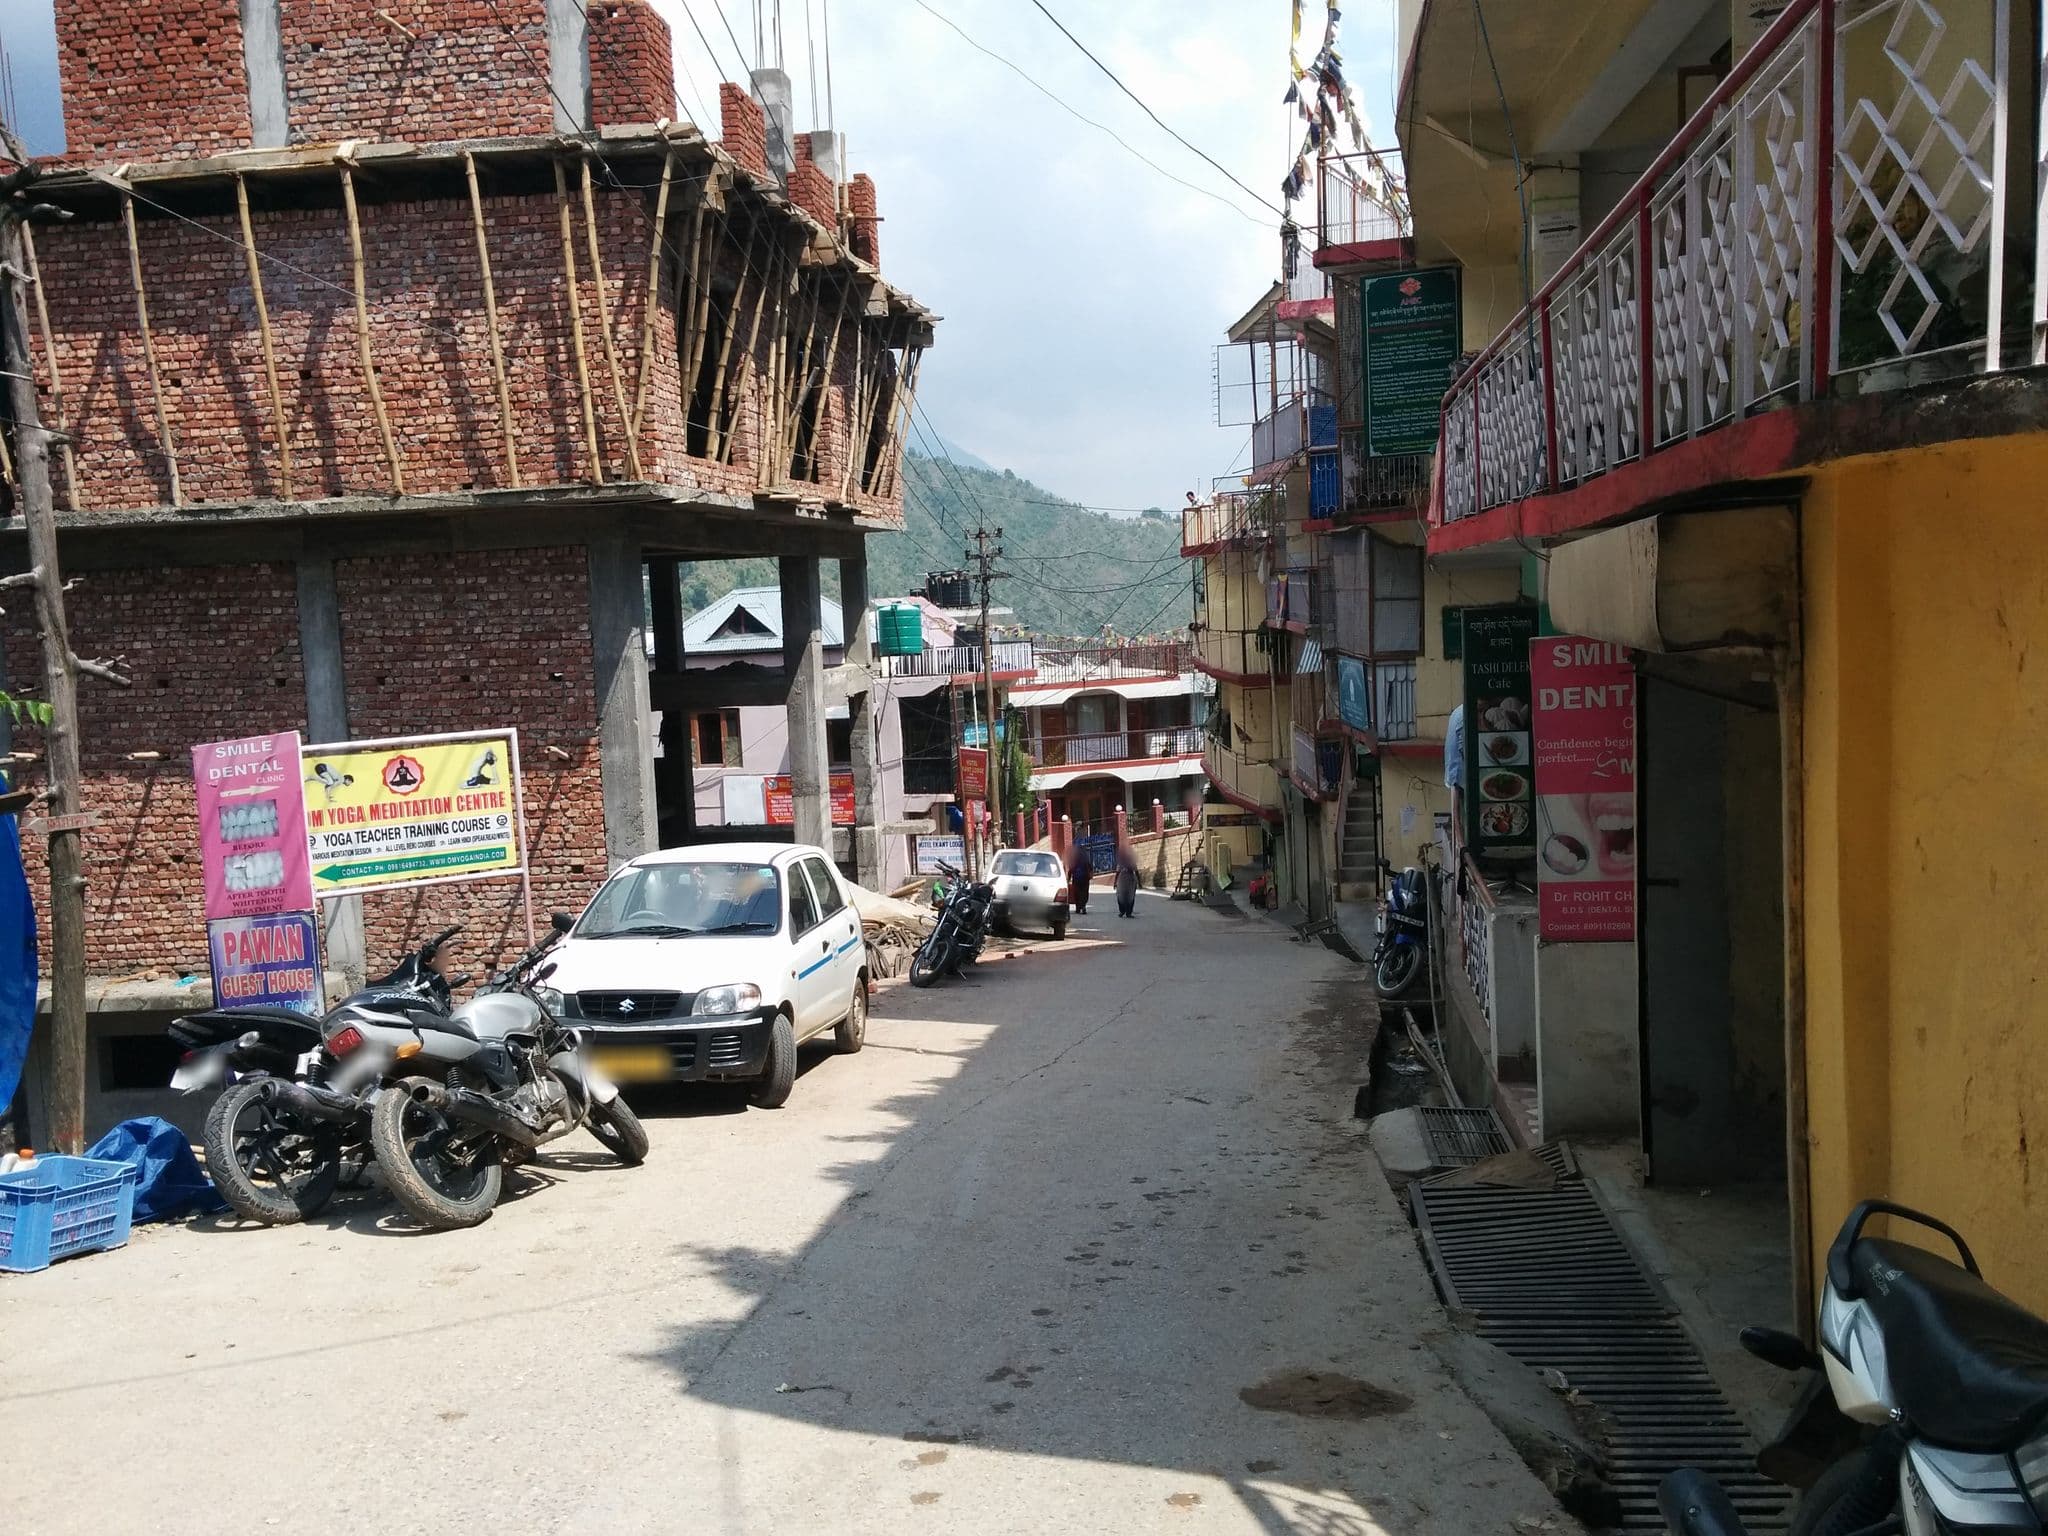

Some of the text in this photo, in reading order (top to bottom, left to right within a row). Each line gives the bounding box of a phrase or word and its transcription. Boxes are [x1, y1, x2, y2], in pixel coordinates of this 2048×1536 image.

[1552, 642, 1630, 668] SMIL
[1472, 662, 1499, 675] TASHI
[1487, 678, 1512, 689] Cafe
[1539, 684, 1636, 711] DENT
[215, 739, 273, 759] SMILE
[1537, 738, 1601, 750] Confidence
[209, 759, 283, 780] DENTAL
[256, 774, 285, 784] CLINIC
[309, 791, 506, 828] M YOGA MEDITATION CENTRE
[323, 817, 491, 847] YOGA TEACHER TRAINING COURSE
[232, 841, 266, 851] BEFORE
[331, 849, 354, 859] MEDITATION
[385, 844, 393, 852] ALL
[393, 843, 406, 851] LEVEL
[418, 840, 436, 849] COURSES
[448, 837, 460, 845] LEARN
[461, 836, 471, 844] HINDI
[227, 887, 286, 900] AFTER TOOTH
[1573, 891, 1611, 902] ROHIT
[1614, 891, 1635, 901] CH
[232, 896, 284, 907] WHITENING
[232, 904, 284, 915] TREATMENT
[1547, 922, 1581, 931] Contact
[223, 924, 305, 967] PAWAN
[220, 968, 314, 999] GUEST HOUSE
